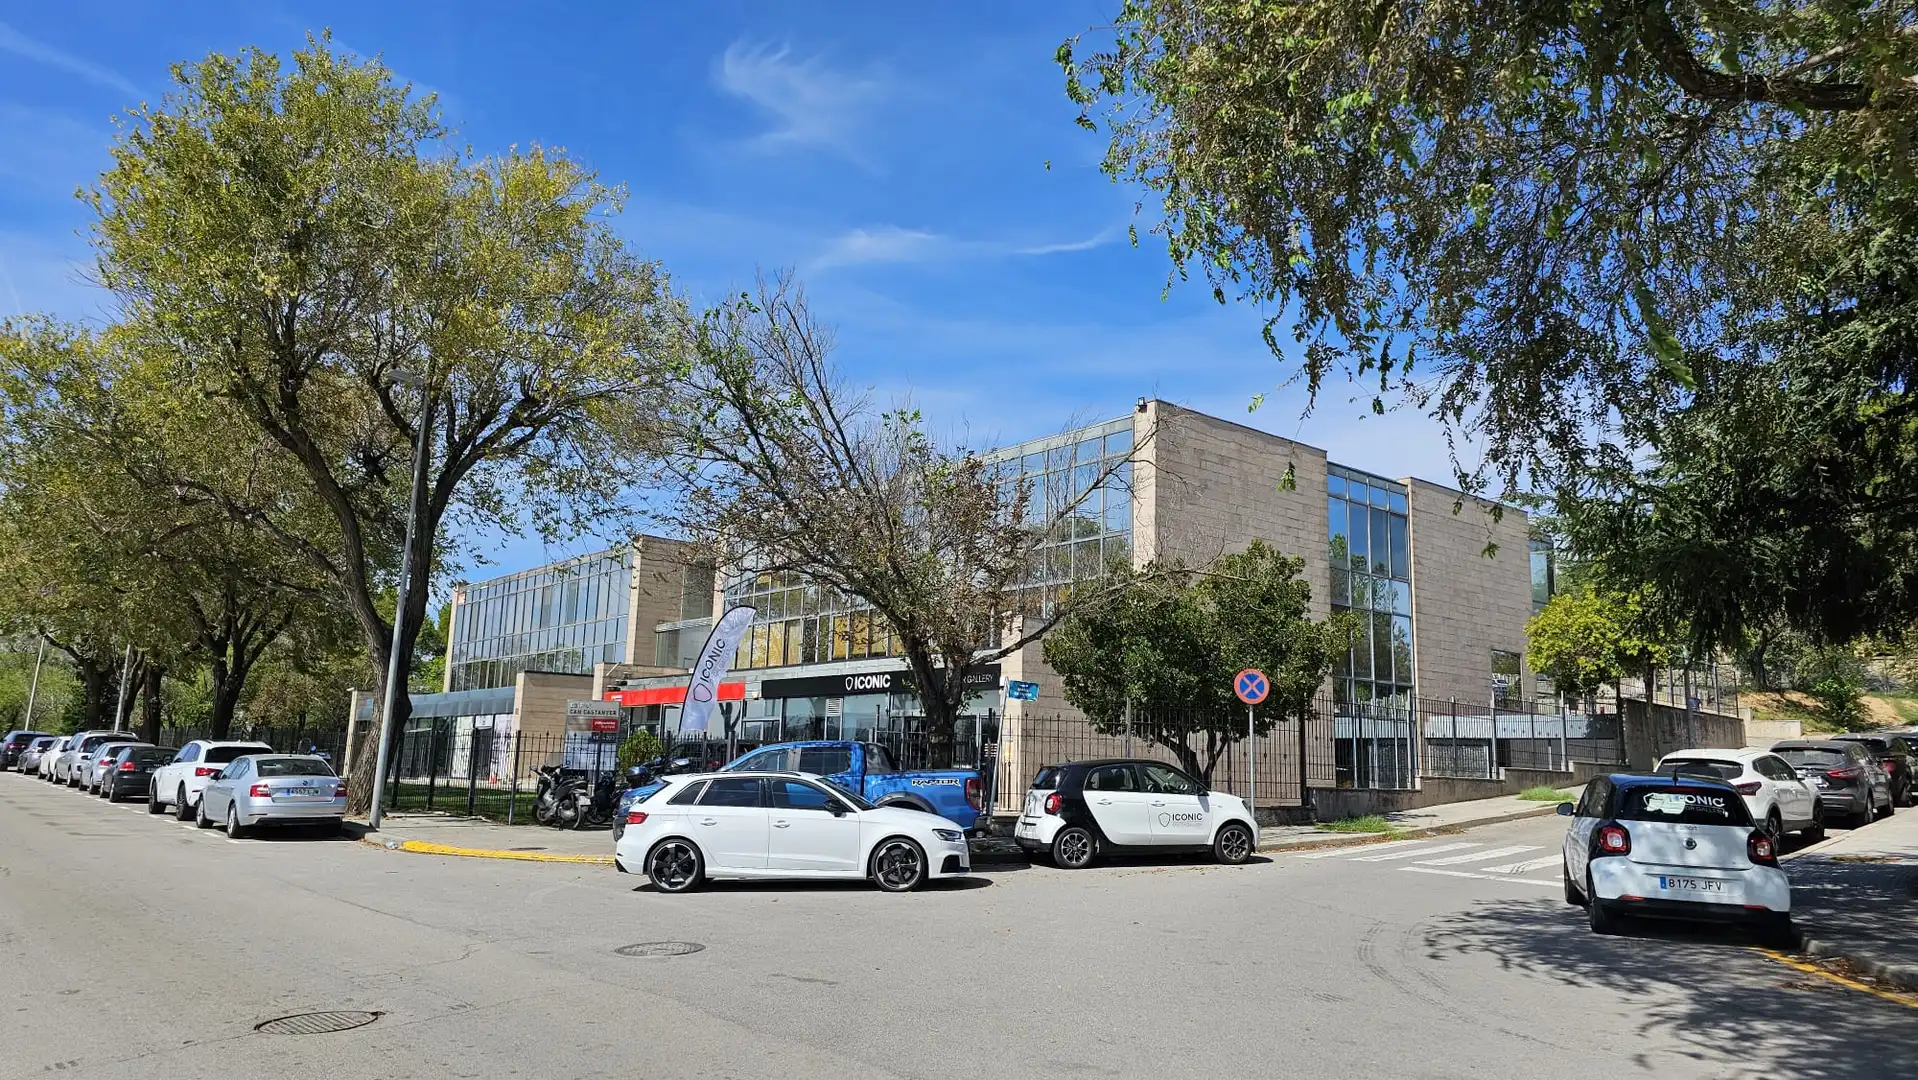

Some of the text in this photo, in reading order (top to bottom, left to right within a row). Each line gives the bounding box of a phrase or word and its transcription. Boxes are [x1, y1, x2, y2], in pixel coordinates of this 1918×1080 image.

[700, 638, 726, 683] ICONIC
[854, 674, 891, 689] ICONIC
[967, 673, 993, 683] GALLERY
[912, 778, 961, 788] RAPTOR
[1172, 812, 1203, 821] ICONIC
[1668, 878, 1722, 891] 8175 JFV
